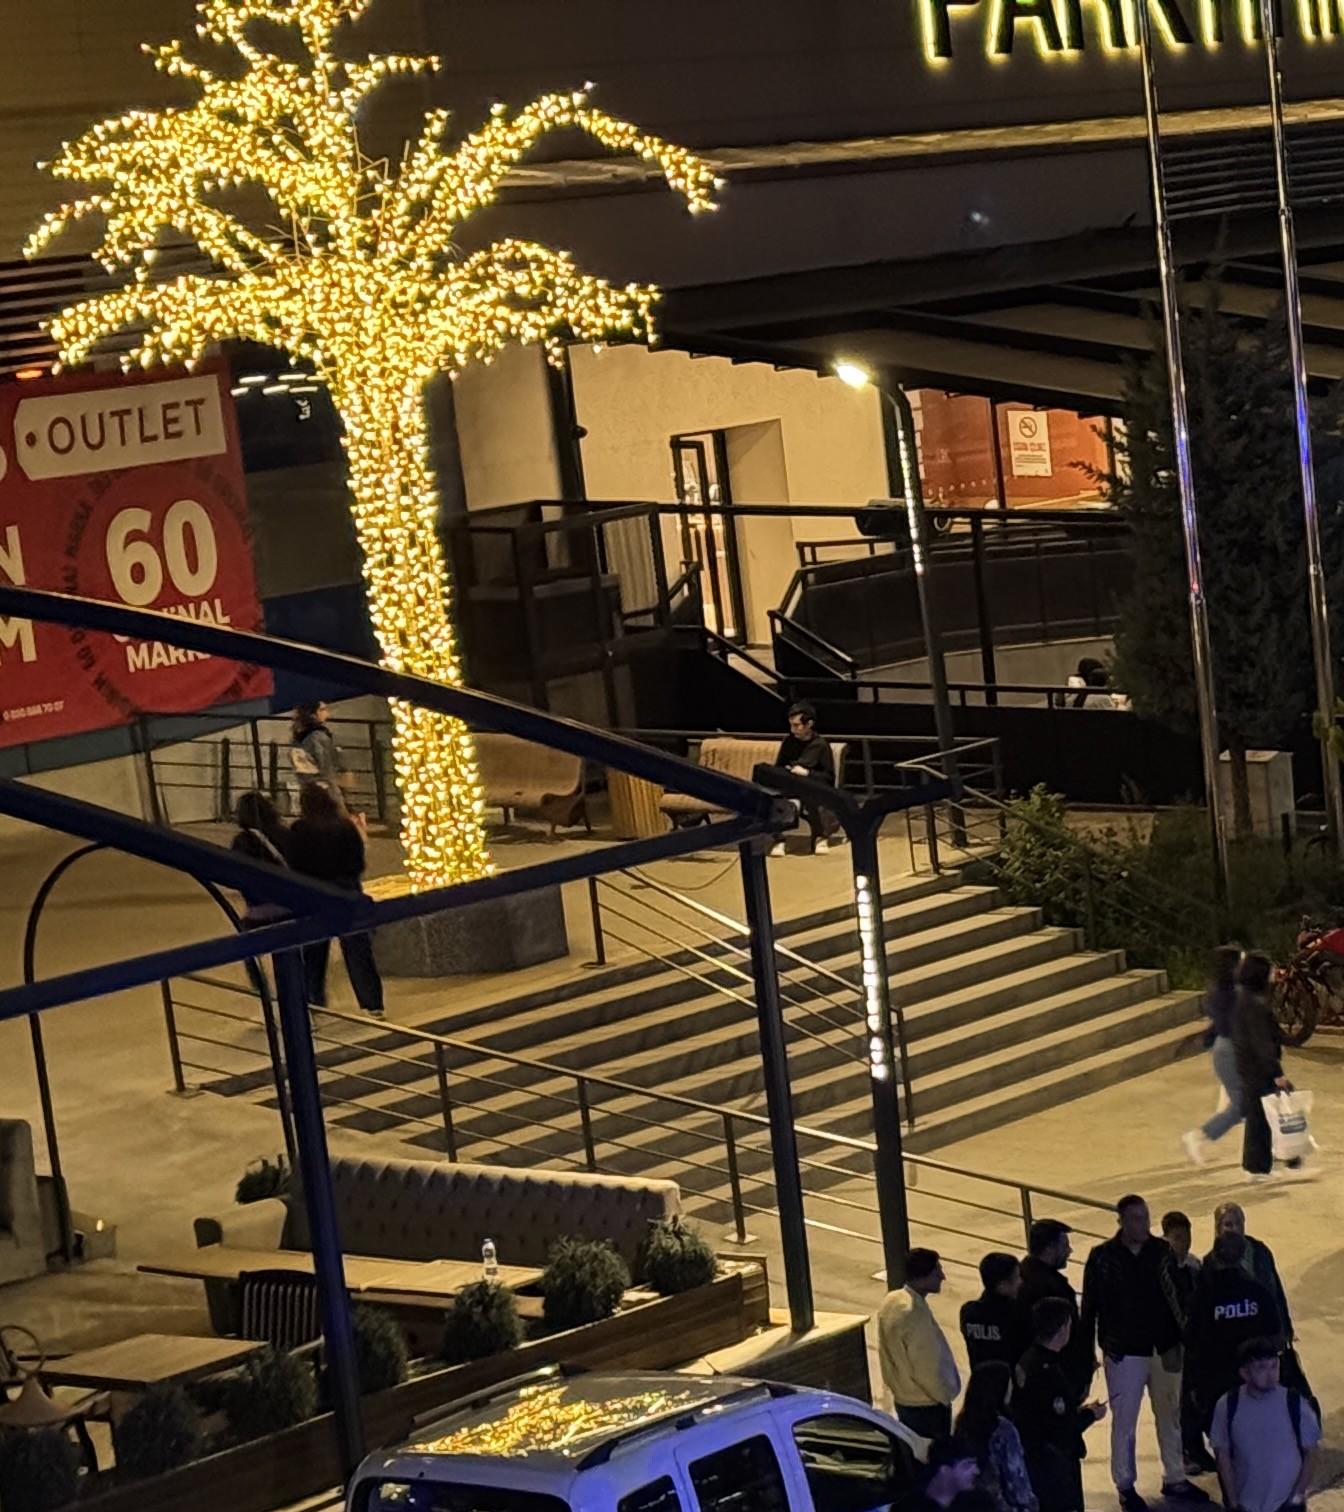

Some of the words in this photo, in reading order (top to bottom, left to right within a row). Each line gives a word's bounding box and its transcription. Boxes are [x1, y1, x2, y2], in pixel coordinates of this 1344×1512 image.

[48, 398, 206, 455] OUTLET
[105, 499, 218, 606] 60
[1214, 1298, 1259, 1320] POLİS
